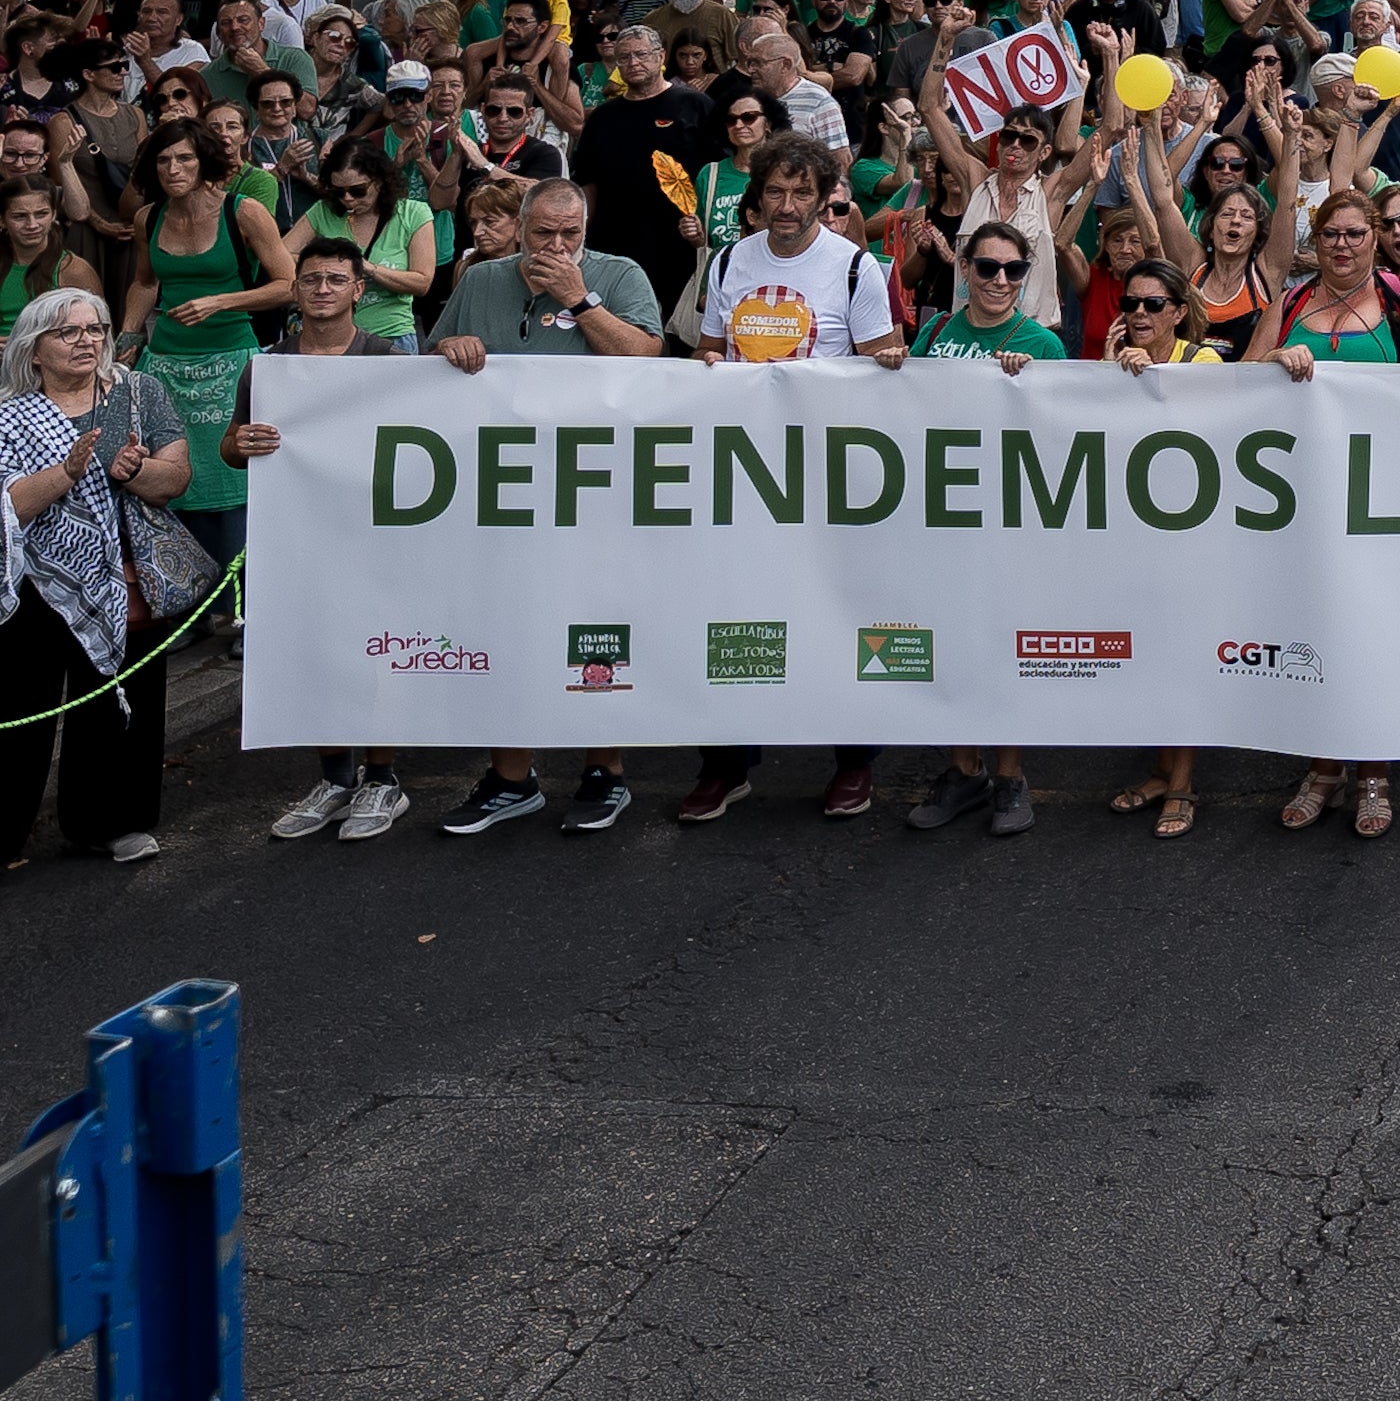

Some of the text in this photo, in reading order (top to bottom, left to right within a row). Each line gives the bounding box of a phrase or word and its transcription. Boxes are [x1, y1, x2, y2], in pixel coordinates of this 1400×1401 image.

[945, 32, 1057, 137] NO
[740, 314, 800, 326] COMEDOR
[734, 324, 803, 337] UNIVERSAL
[372, 424, 1303, 527] DEFENDEMOS
[710, 625, 757, 639] ESCUELA
[895, 636, 922, 645] MENOS
[1021, 635, 1096, 654] CCOO
[577, 642, 590, 654] SIN
[720, 647, 736, 659] DE
[891, 645, 926, 654] LECTIVAS
[901, 657, 931, 665] CALIDAD
[1217, 640, 1282, 670] CGT
[889, 665, 927, 673] EDUCATIVA
[1018, 659, 1122, 671] educación y servicios
[1018, 668, 1098, 679] socioeducativos
